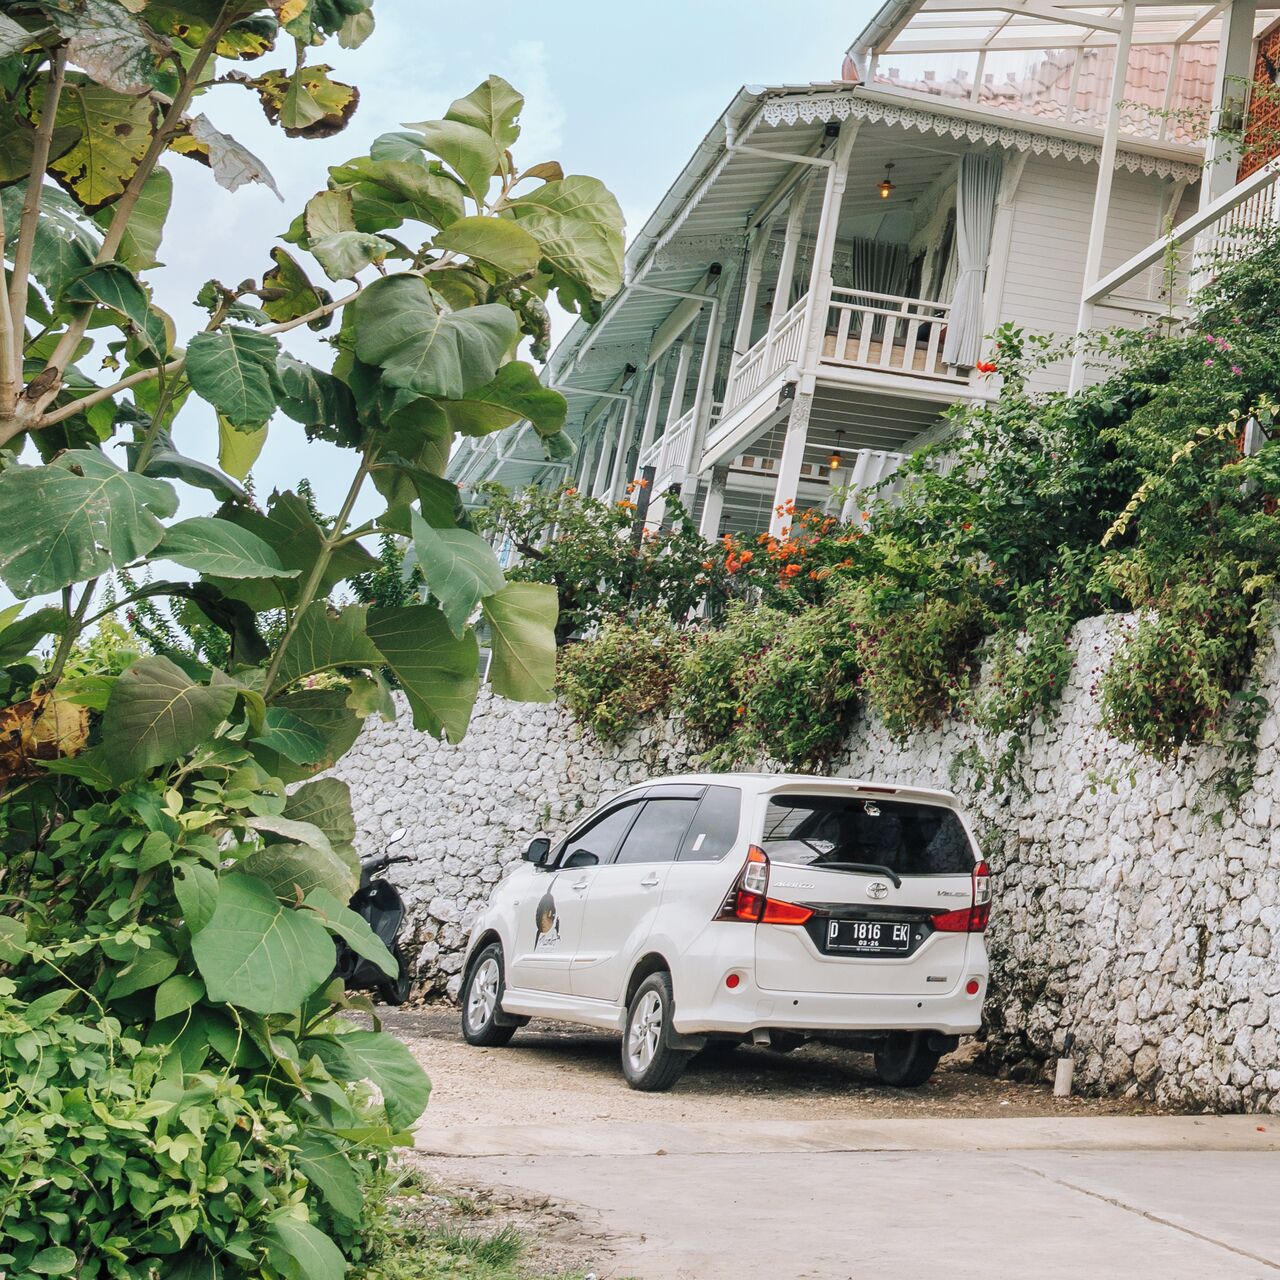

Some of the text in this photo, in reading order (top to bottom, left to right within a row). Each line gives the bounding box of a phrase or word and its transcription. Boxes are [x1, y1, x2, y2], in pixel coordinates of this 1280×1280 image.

[830, 922, 908, 941] D 1816 EK
